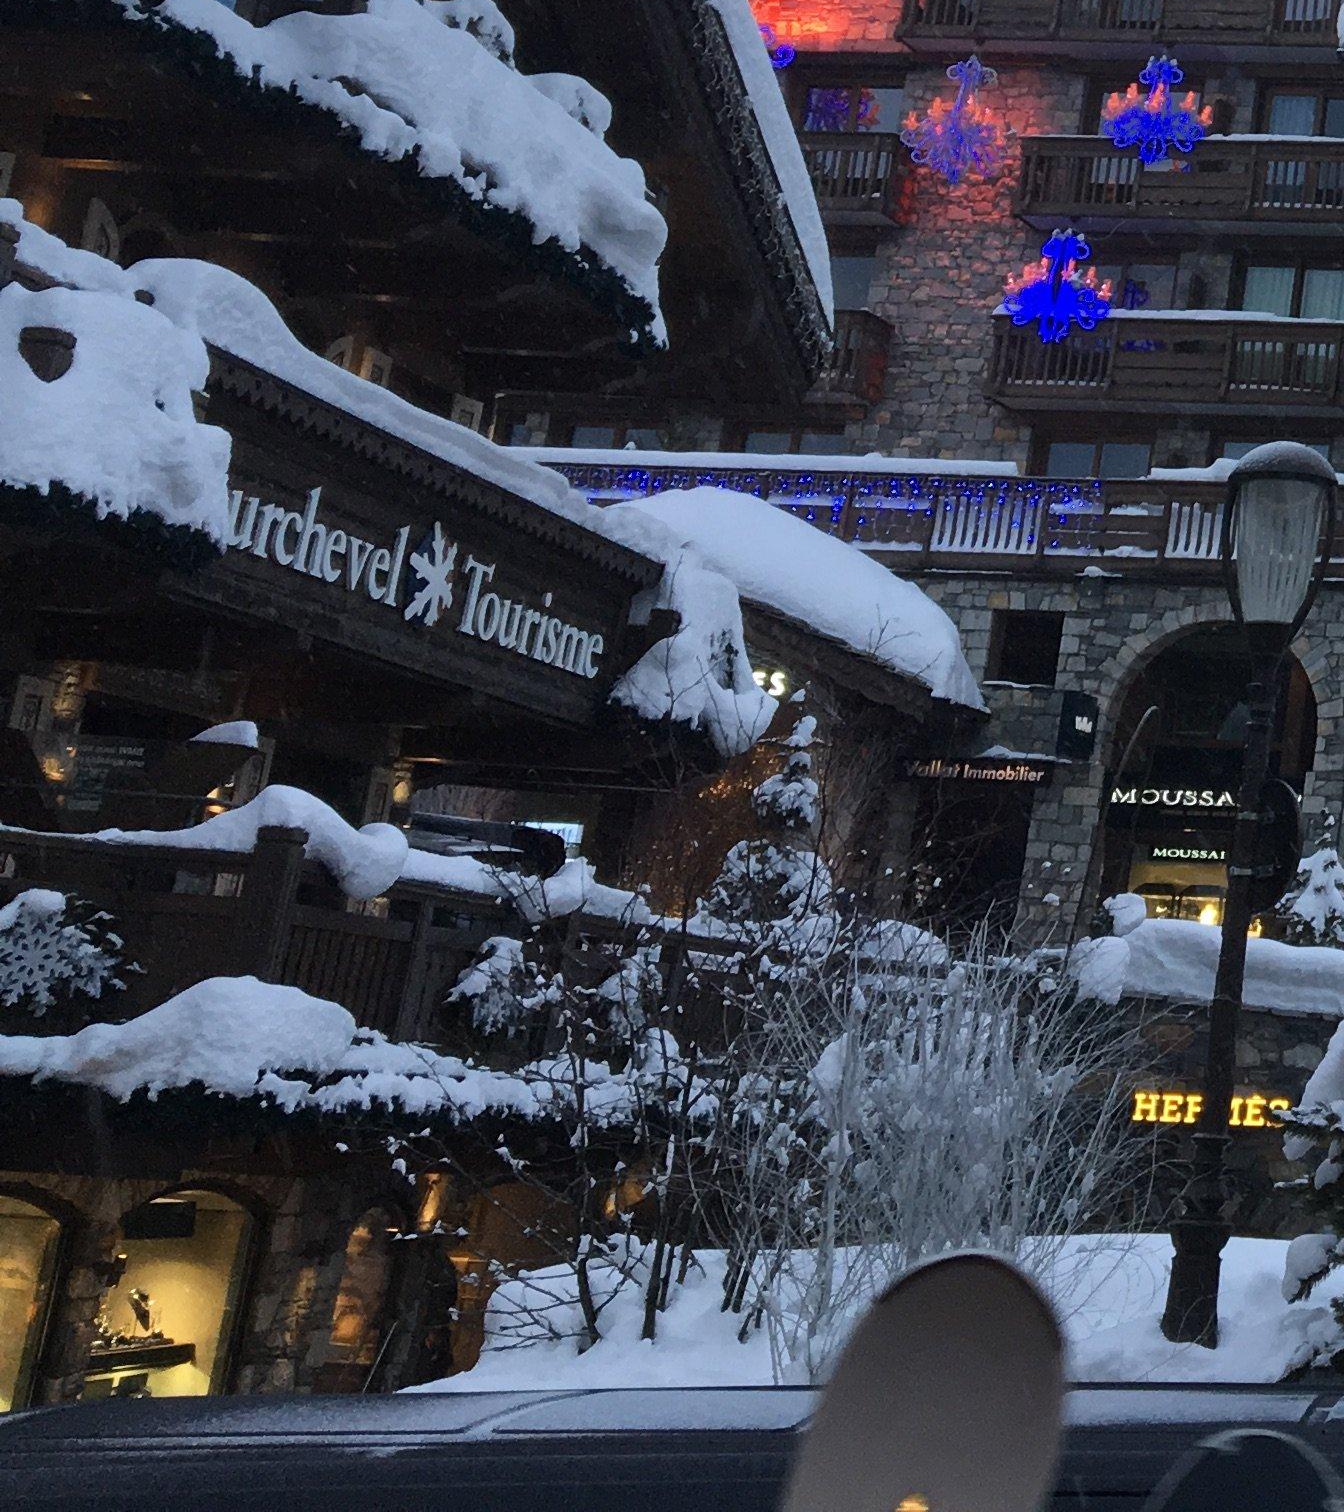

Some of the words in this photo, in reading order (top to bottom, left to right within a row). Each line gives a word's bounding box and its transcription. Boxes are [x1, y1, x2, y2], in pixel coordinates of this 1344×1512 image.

[227, 486, 411, 607] urchevel
[458, 554, 604, 679] Tourisme
[963, 764, 1045, 782] Immobilier
[1111, 787, 1240, 807] MOUSSA
[1152, 847, 1226, 860] MOUSSAI
